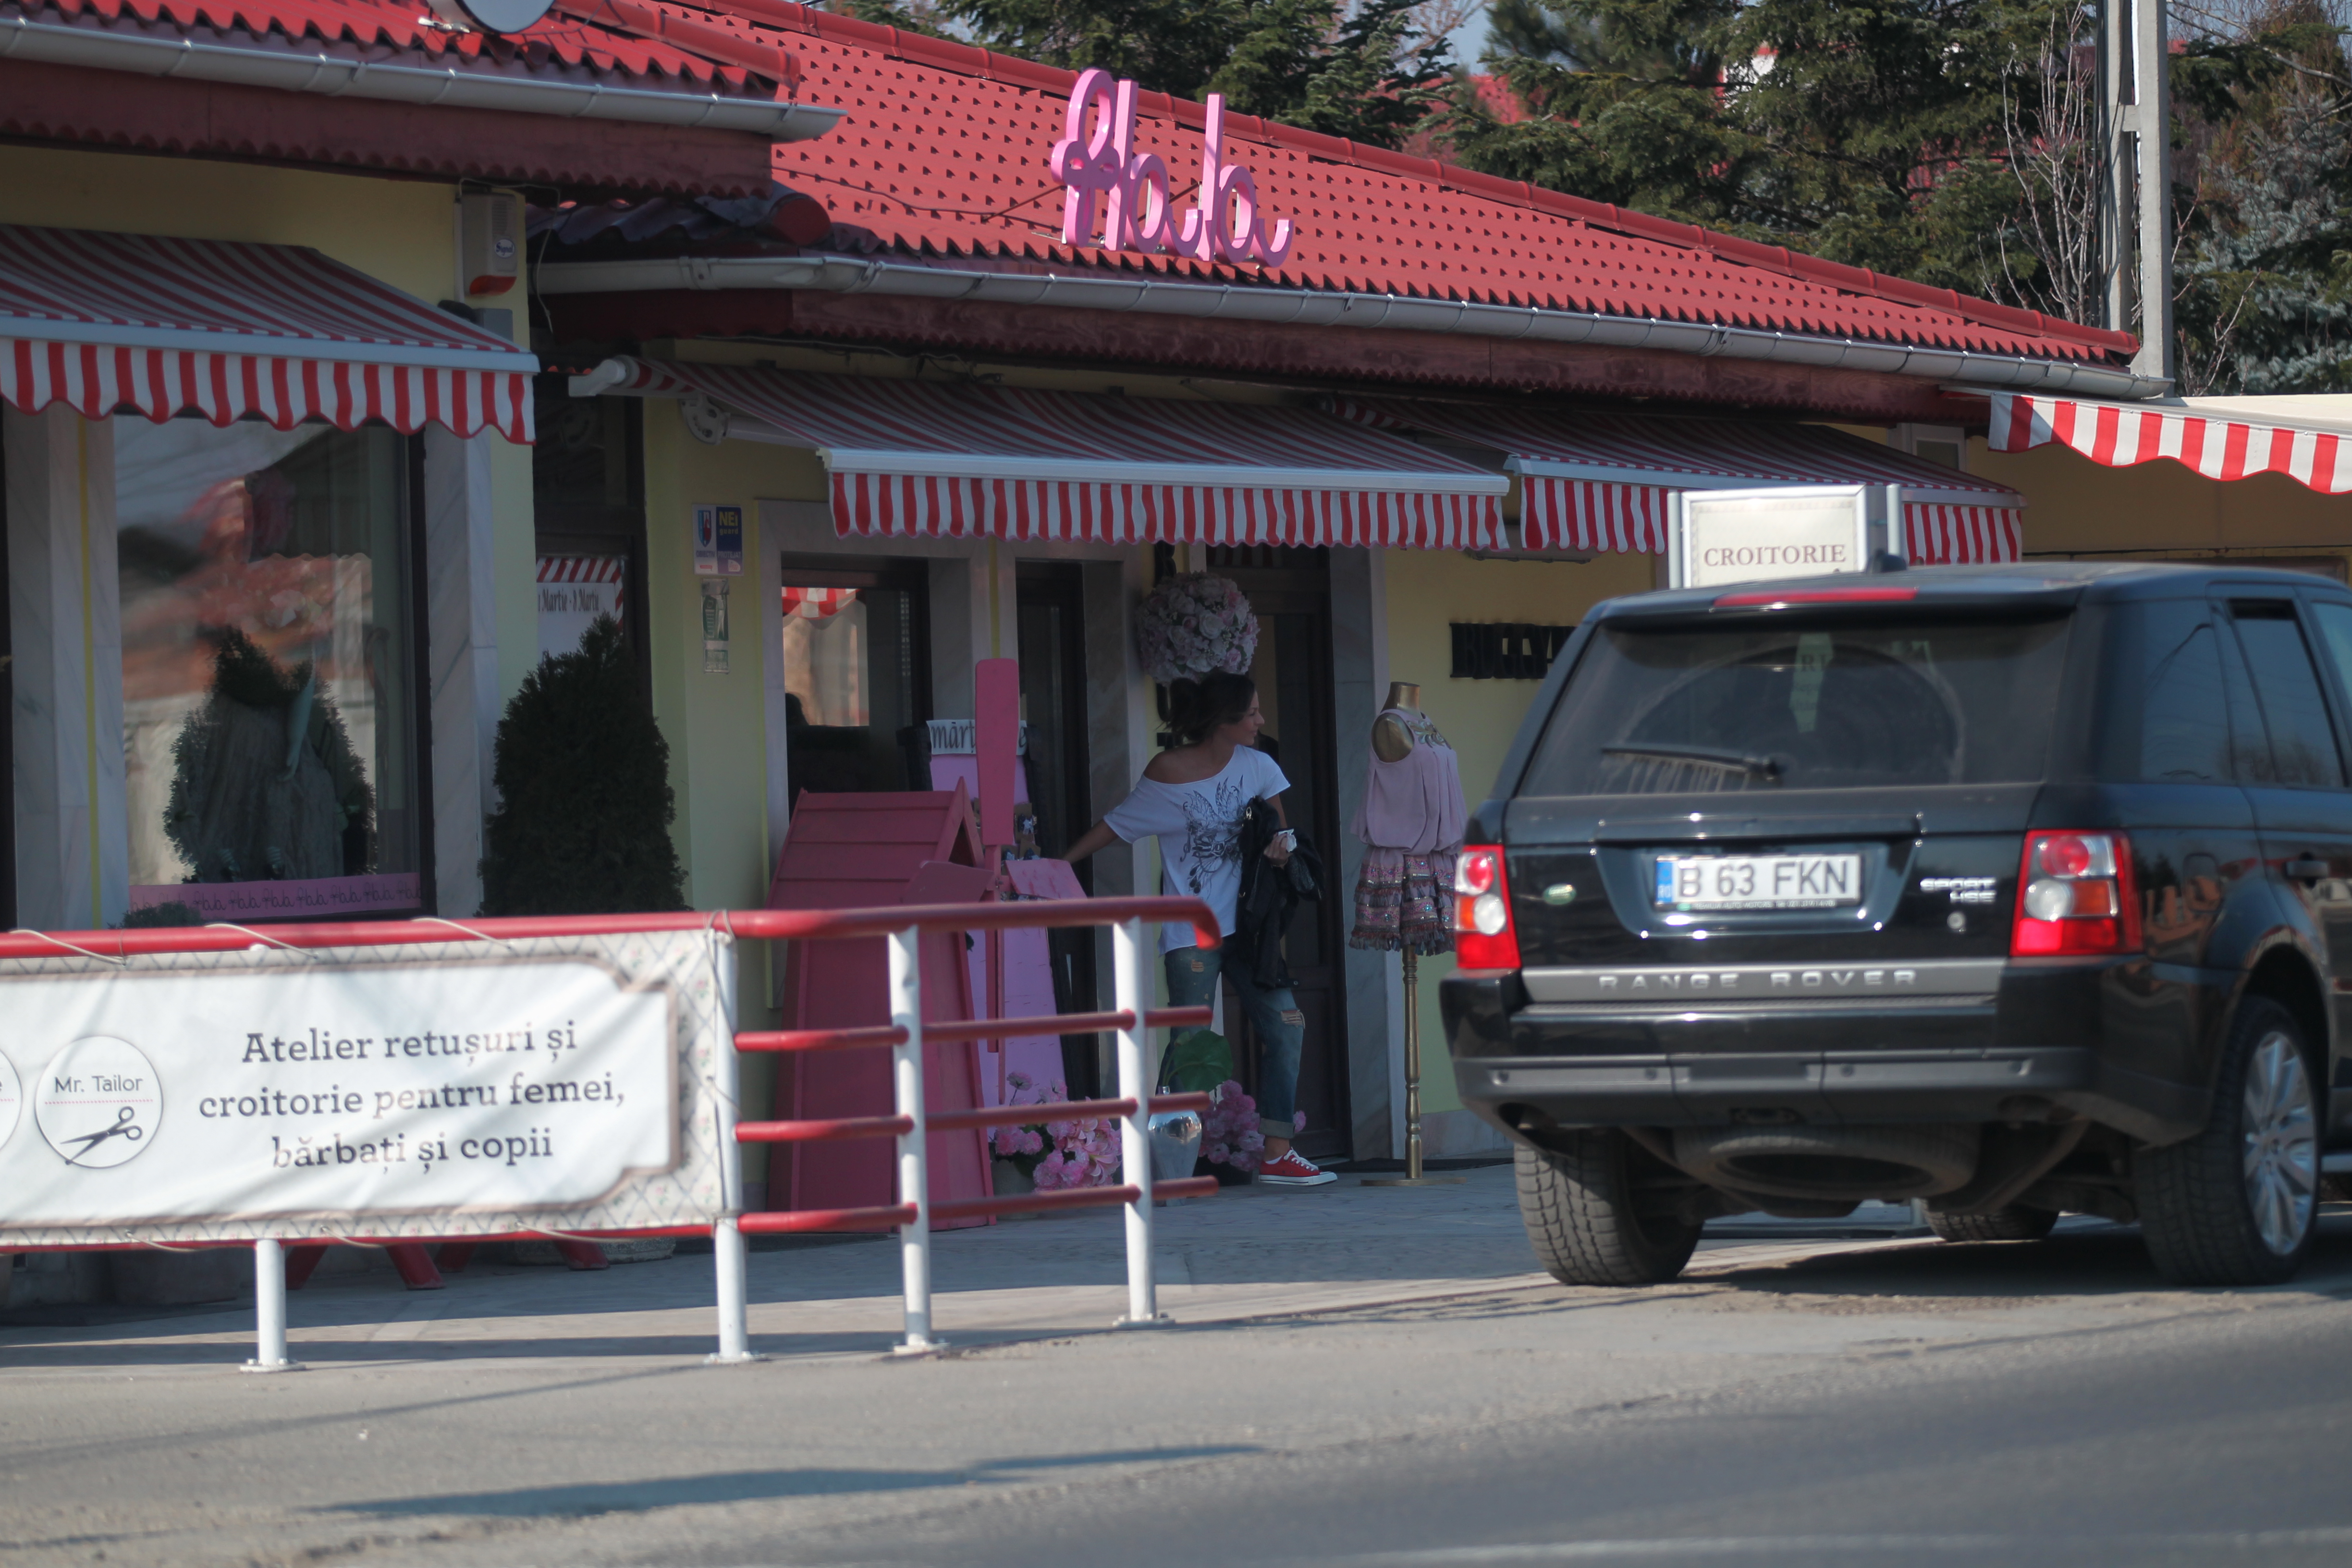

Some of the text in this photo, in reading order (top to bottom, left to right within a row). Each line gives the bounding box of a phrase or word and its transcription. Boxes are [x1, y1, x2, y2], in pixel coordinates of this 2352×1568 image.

[1703, 544, 1846, 567] CROITORIE
[542, 588, 568, 612] Martie
[1678, 859, 1847, 897] B 63 FKN
[1920, 878, 1997, 892] SPORT
[1949, 890, 1997, 904] HSE
[1599, 968, 1917, 991] RANGE ROVER
[243, 1020, 576, 1066] Atelier retușuri și
[55, 1074, 143, 1093] Mr. Tailor
[199, 1071, 624, 1119] croitorie pentru femei,
[272, 1127, 553, 1174] bărbați și copii
